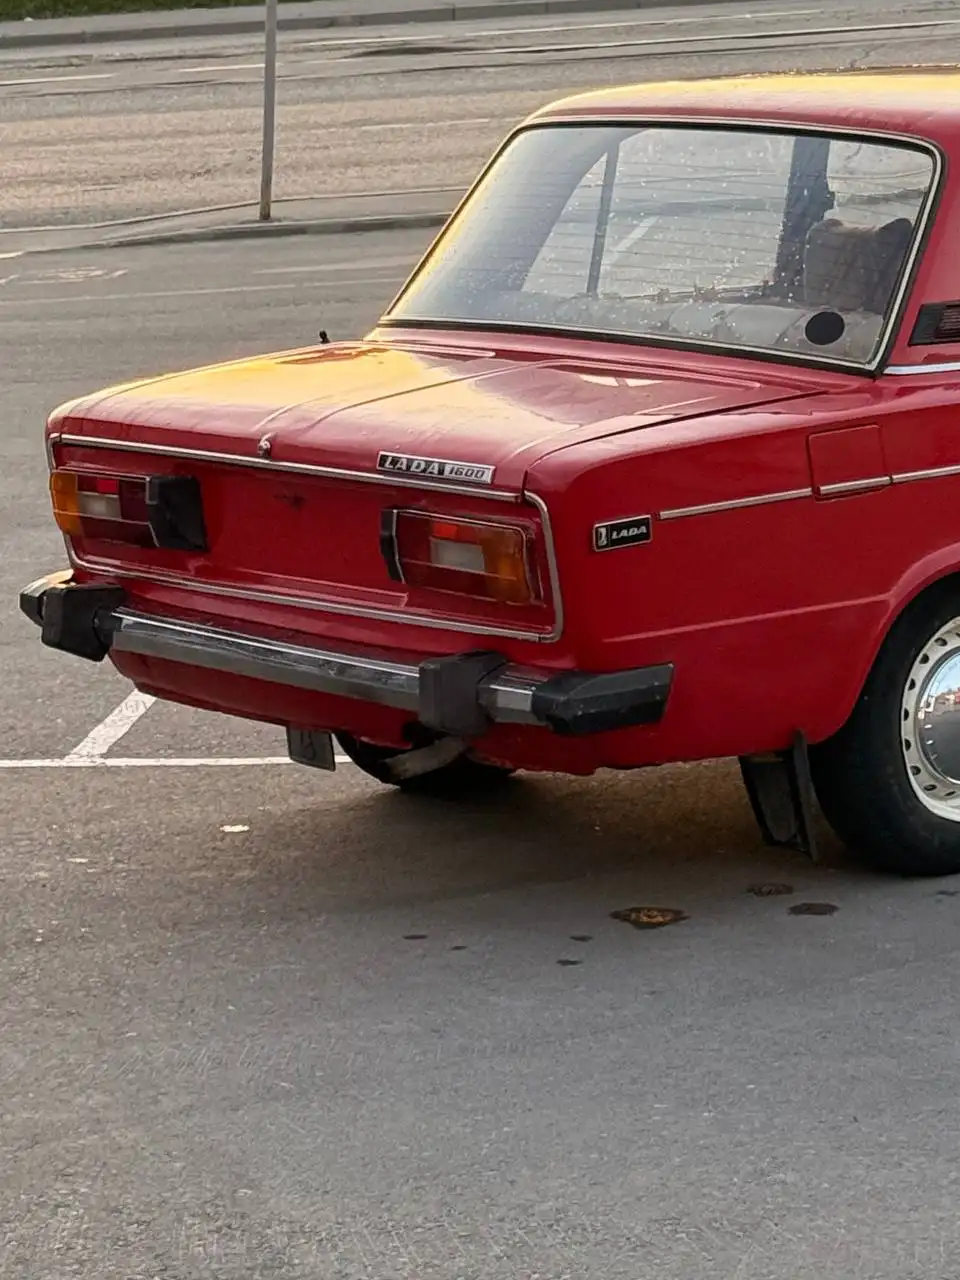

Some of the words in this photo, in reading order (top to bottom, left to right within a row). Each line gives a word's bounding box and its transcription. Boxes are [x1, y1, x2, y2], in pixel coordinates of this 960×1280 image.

[383, 456, 440, 475] LADA
[448, 466, 486, 479] 1600
[611, 525, 647, 540] LADA
